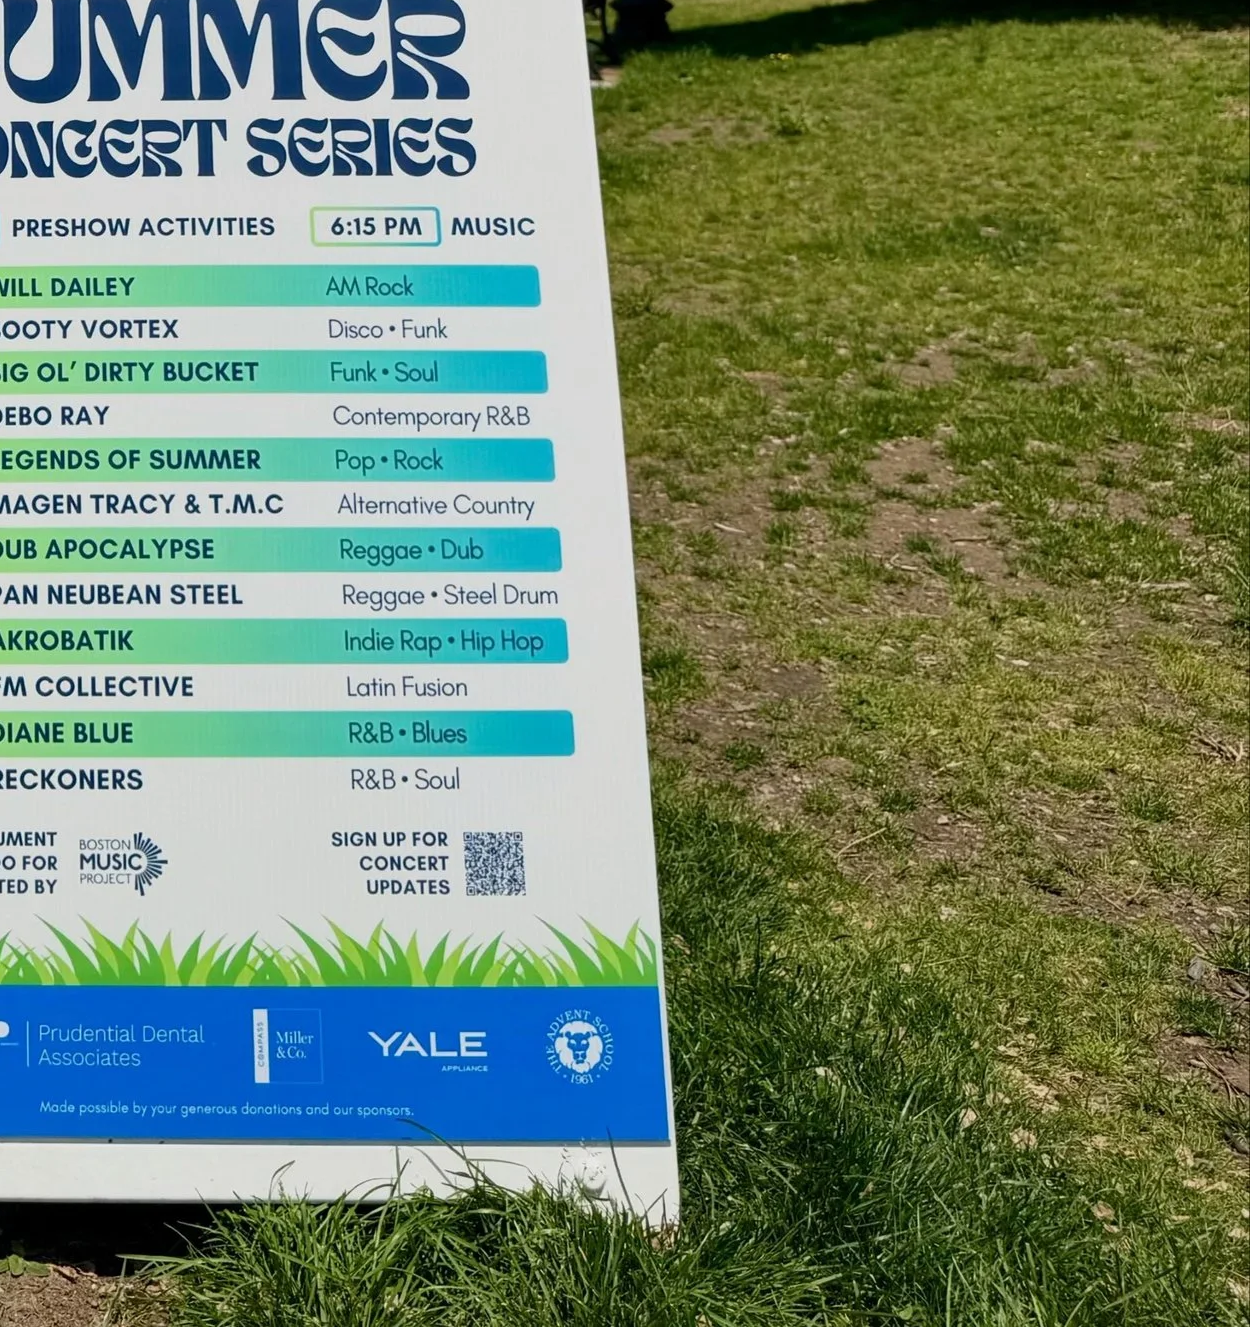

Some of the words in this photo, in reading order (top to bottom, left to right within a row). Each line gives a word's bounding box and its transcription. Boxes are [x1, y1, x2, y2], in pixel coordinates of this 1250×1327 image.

[246, 118, 476, 177] SERIES
[13, 218, 130, 237] PRESHOW
[139, 217, 274, 236] ACTIVITIES
[331, 217, 375, 235] 6:15
[385, 217, 422, 235] PM
[452, 217, 534, 236] MUSIC
[51, 277, 134, 296] DAILEY
[326, 276, 361, 296] AM
[366, 275, 414, 296] Rock
[81, 320, 178, 338] VORTEX
[329, 319, 383, 338] Disco
[402, 318, 447, 338] Funk
[85, 362, 154, 381] DIRTY
[164, 362, 259, 381] BUCKET
[331, 360, 377, 381] Funk
[395, 360, 438, 382] Soul
[61, 406, 109, 425] RAY
[333, 406, 481, 432] Contemporary
[487, 406, 530, 425] R&B
[108, 450, 140, 469] OF
[150, 450, 261, 469] SUMMER
[336, 449, 375, 476] Pop
[394, 448, 443, 470] Rock
[90, 494, 175, 514] TRACY
[185, 494, 201, 514] &
[209, 494, 283, 514] T.M.C
[338, 493, 447, 514] Alternative
[454, 494, 534, 520] Country
[45, 539, 214, 559] APOCALYPSE
[340, 539, 422, 566] Reggae
[441, 537, 483, 559] Dub
[48, 585, 160, 604] NEUBEAN
[171, 584, 243, 604] STEEL
[343, 584, 424, 611] Reggae
[444, 583, 496, 604] Steel
[504, 584, 558, 604] Drum
[345, 628, 394, 650] Indie
[401, 630, 442, 658] Rap
[461, 630, 495, 657] Hip
[501, 630, 543, 657] Hop
[36, 676, 193, 697] COLLECTIVE
[347, 676, 395, 696] Latin
[402, 676, 467, 696] Fusion
[74, 723, 133, 743] BLUE
[349, 722, 394, 743] R&B
[413, 720, 467, 743] Blues
[351, 769, 396, 790] R&B
[415, 767, 459, 790] Soul
[80, 839, 131, 850] BOSTON
[332, 832, 376, 847] SIGN
[383, 832, 406, 846] UP
[413, 832, 448, 846] FOR
[23, 856, 57, 870] FOR
[79, 852, 143, 872] MUSIC
[360, 856, 449, 871] CONCERT
[35, 880, 57, 894] BY
[80, 873, 131, 884] PROJECT
[367, 880, 450, 894] UPDATES
[40, 1024, 136, 1042] Prudential
[143, 1025, 204, 1043] Dental
[547, 1009, 591, 1042] ADVENT
[276, 1030, 314, 1044] Miller
[368, 1032, 487, 1056] YALE
[592, 1016, 614, 1071] SCHOOL
[39, 1049, 140, 1066] Associates
[277, 1045, 306, 1059] &Co.
[546, 1044, 562, 1074] THE
[571, 1073, 593, 1084] 1961
[40, 1100, 75, 1112] Made
[80, 1100, 129, 1116] possible
[133, 1101, 147, 1117] by
[151, 1106, 176, 1117] your
[181, 1106, 237, 1118] generous
[242, 1102, 302, 1115] donations
[306, 1103, 329, 1115] and
[334, 1107, 353, 1115] our
[357, 1107, 414, 1118] sponsors.
